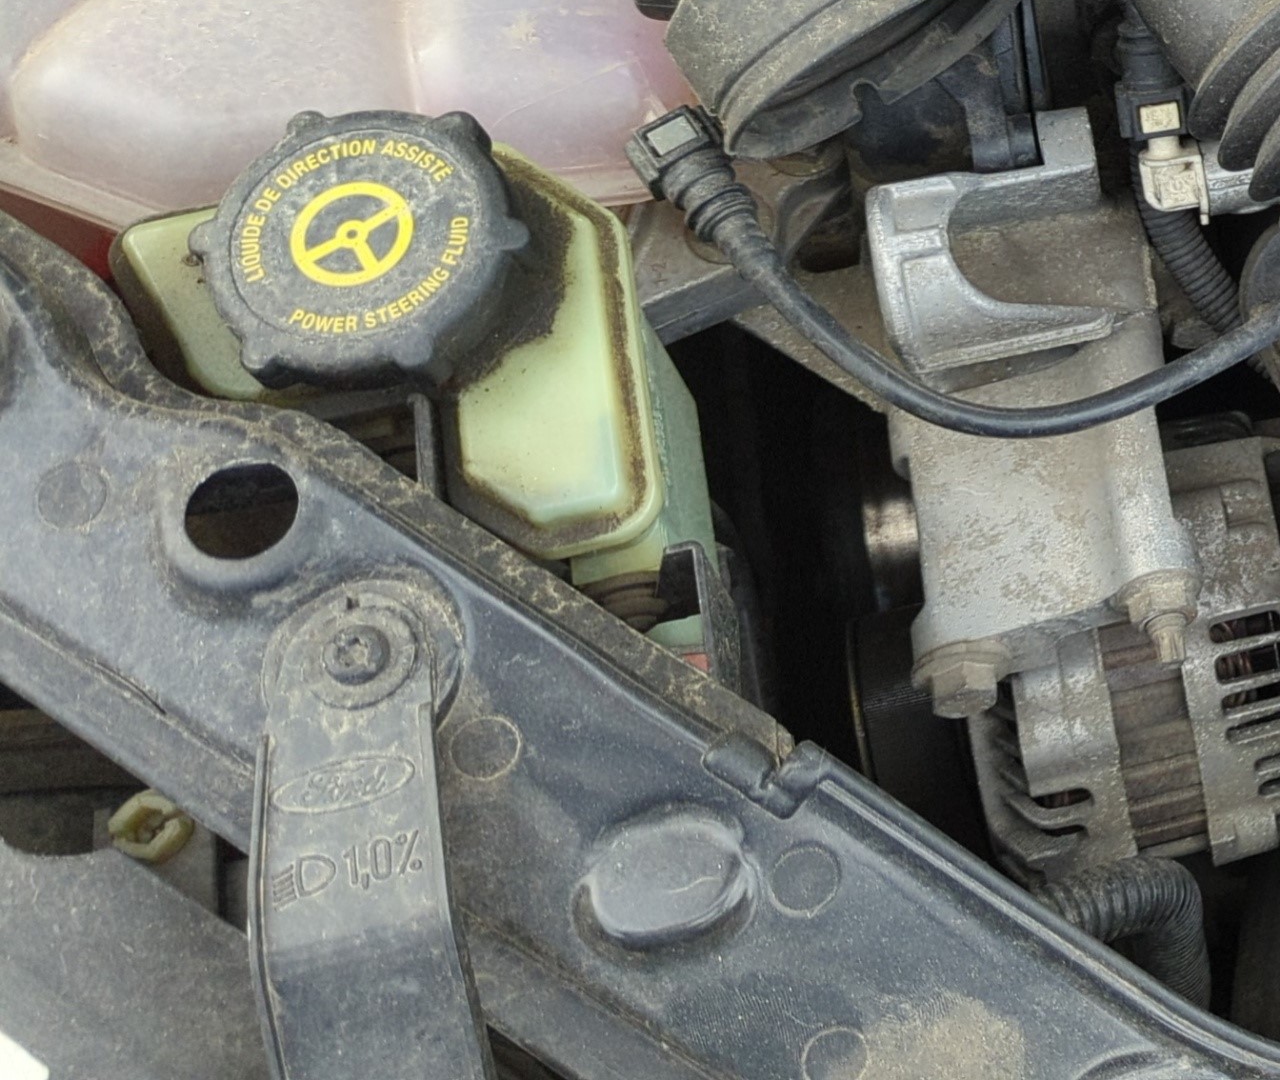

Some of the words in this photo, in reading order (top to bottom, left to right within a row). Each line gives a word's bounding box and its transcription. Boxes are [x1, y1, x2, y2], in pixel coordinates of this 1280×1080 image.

[241, 213, 265, 283] LIQUIDE
[256, 187, 281, 213] DE
[276, 139, 376, 189] DIRECTION
[289, 308, 358, 333] POWER
[366, 268, 449, 328] STEERING
[442, 215, 469, 266] FLUID
[302, 762, 388, 805] Ford
[342, 829, 422, 890] 1,0%
